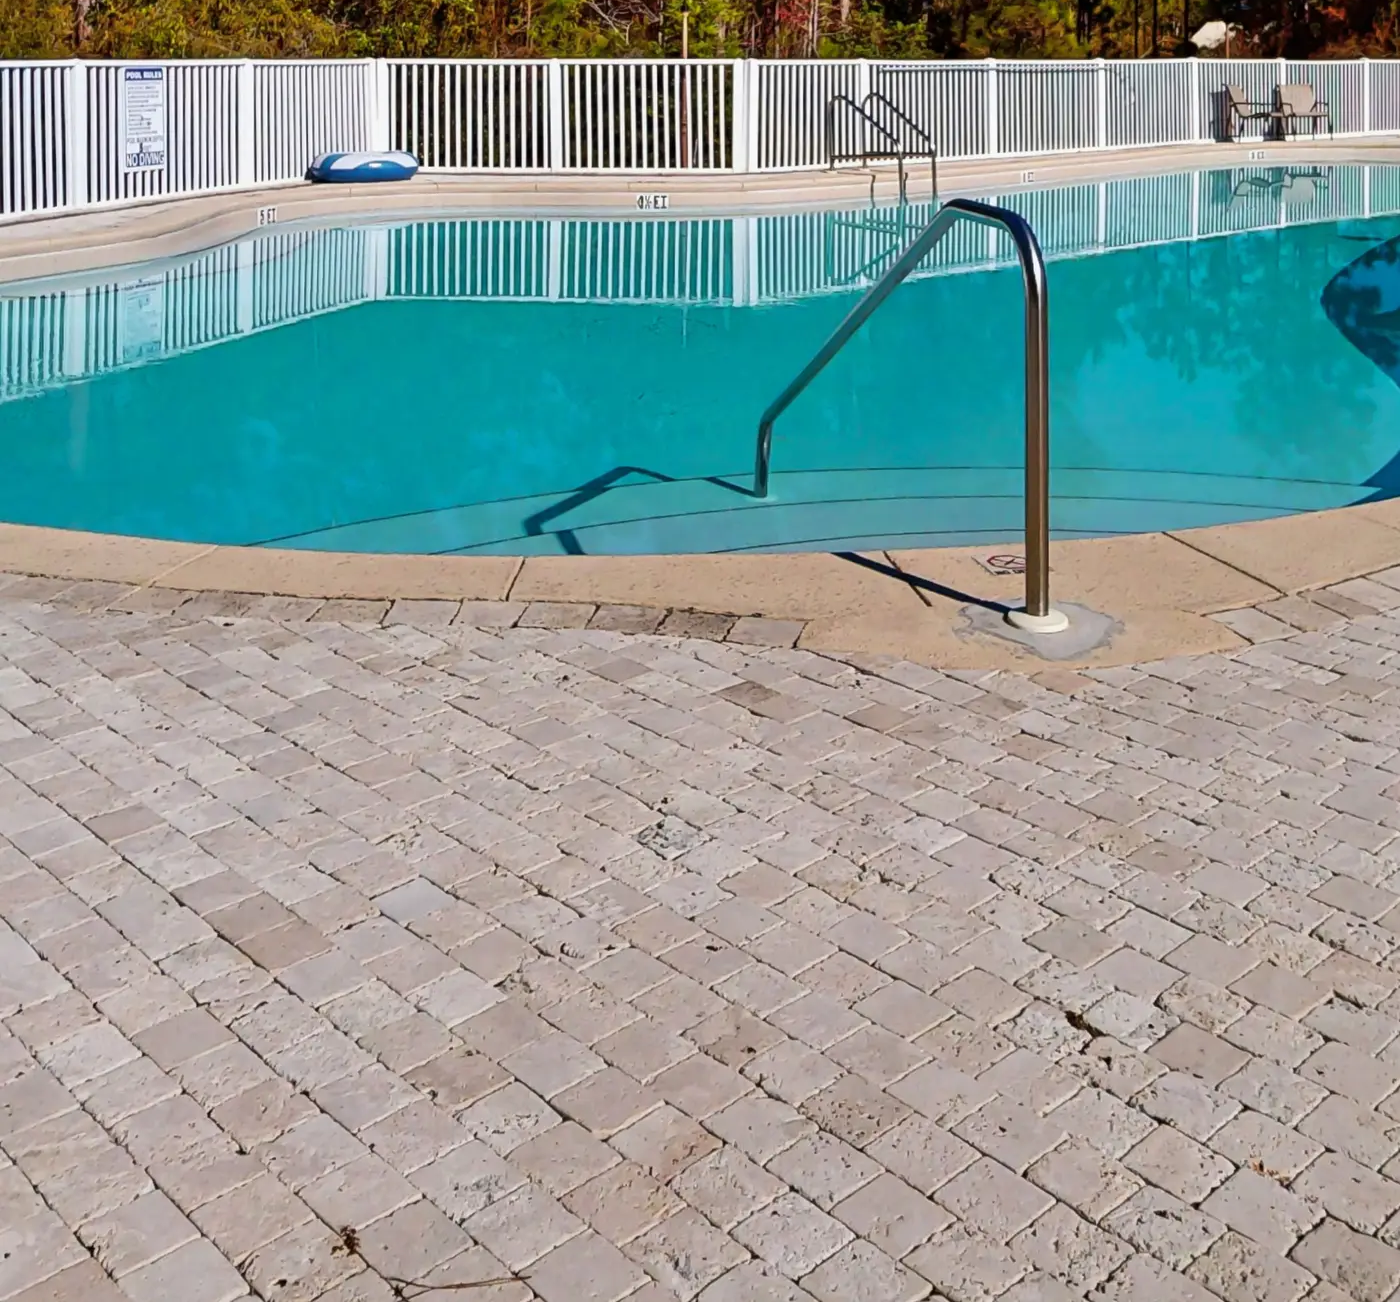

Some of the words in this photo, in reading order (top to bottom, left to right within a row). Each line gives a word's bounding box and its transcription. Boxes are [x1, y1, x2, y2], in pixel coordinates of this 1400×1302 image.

[126, 71, 142, 79] POOL
[127, 153, 138, 167] NO
[139, 151, 164, 166] DIVING
